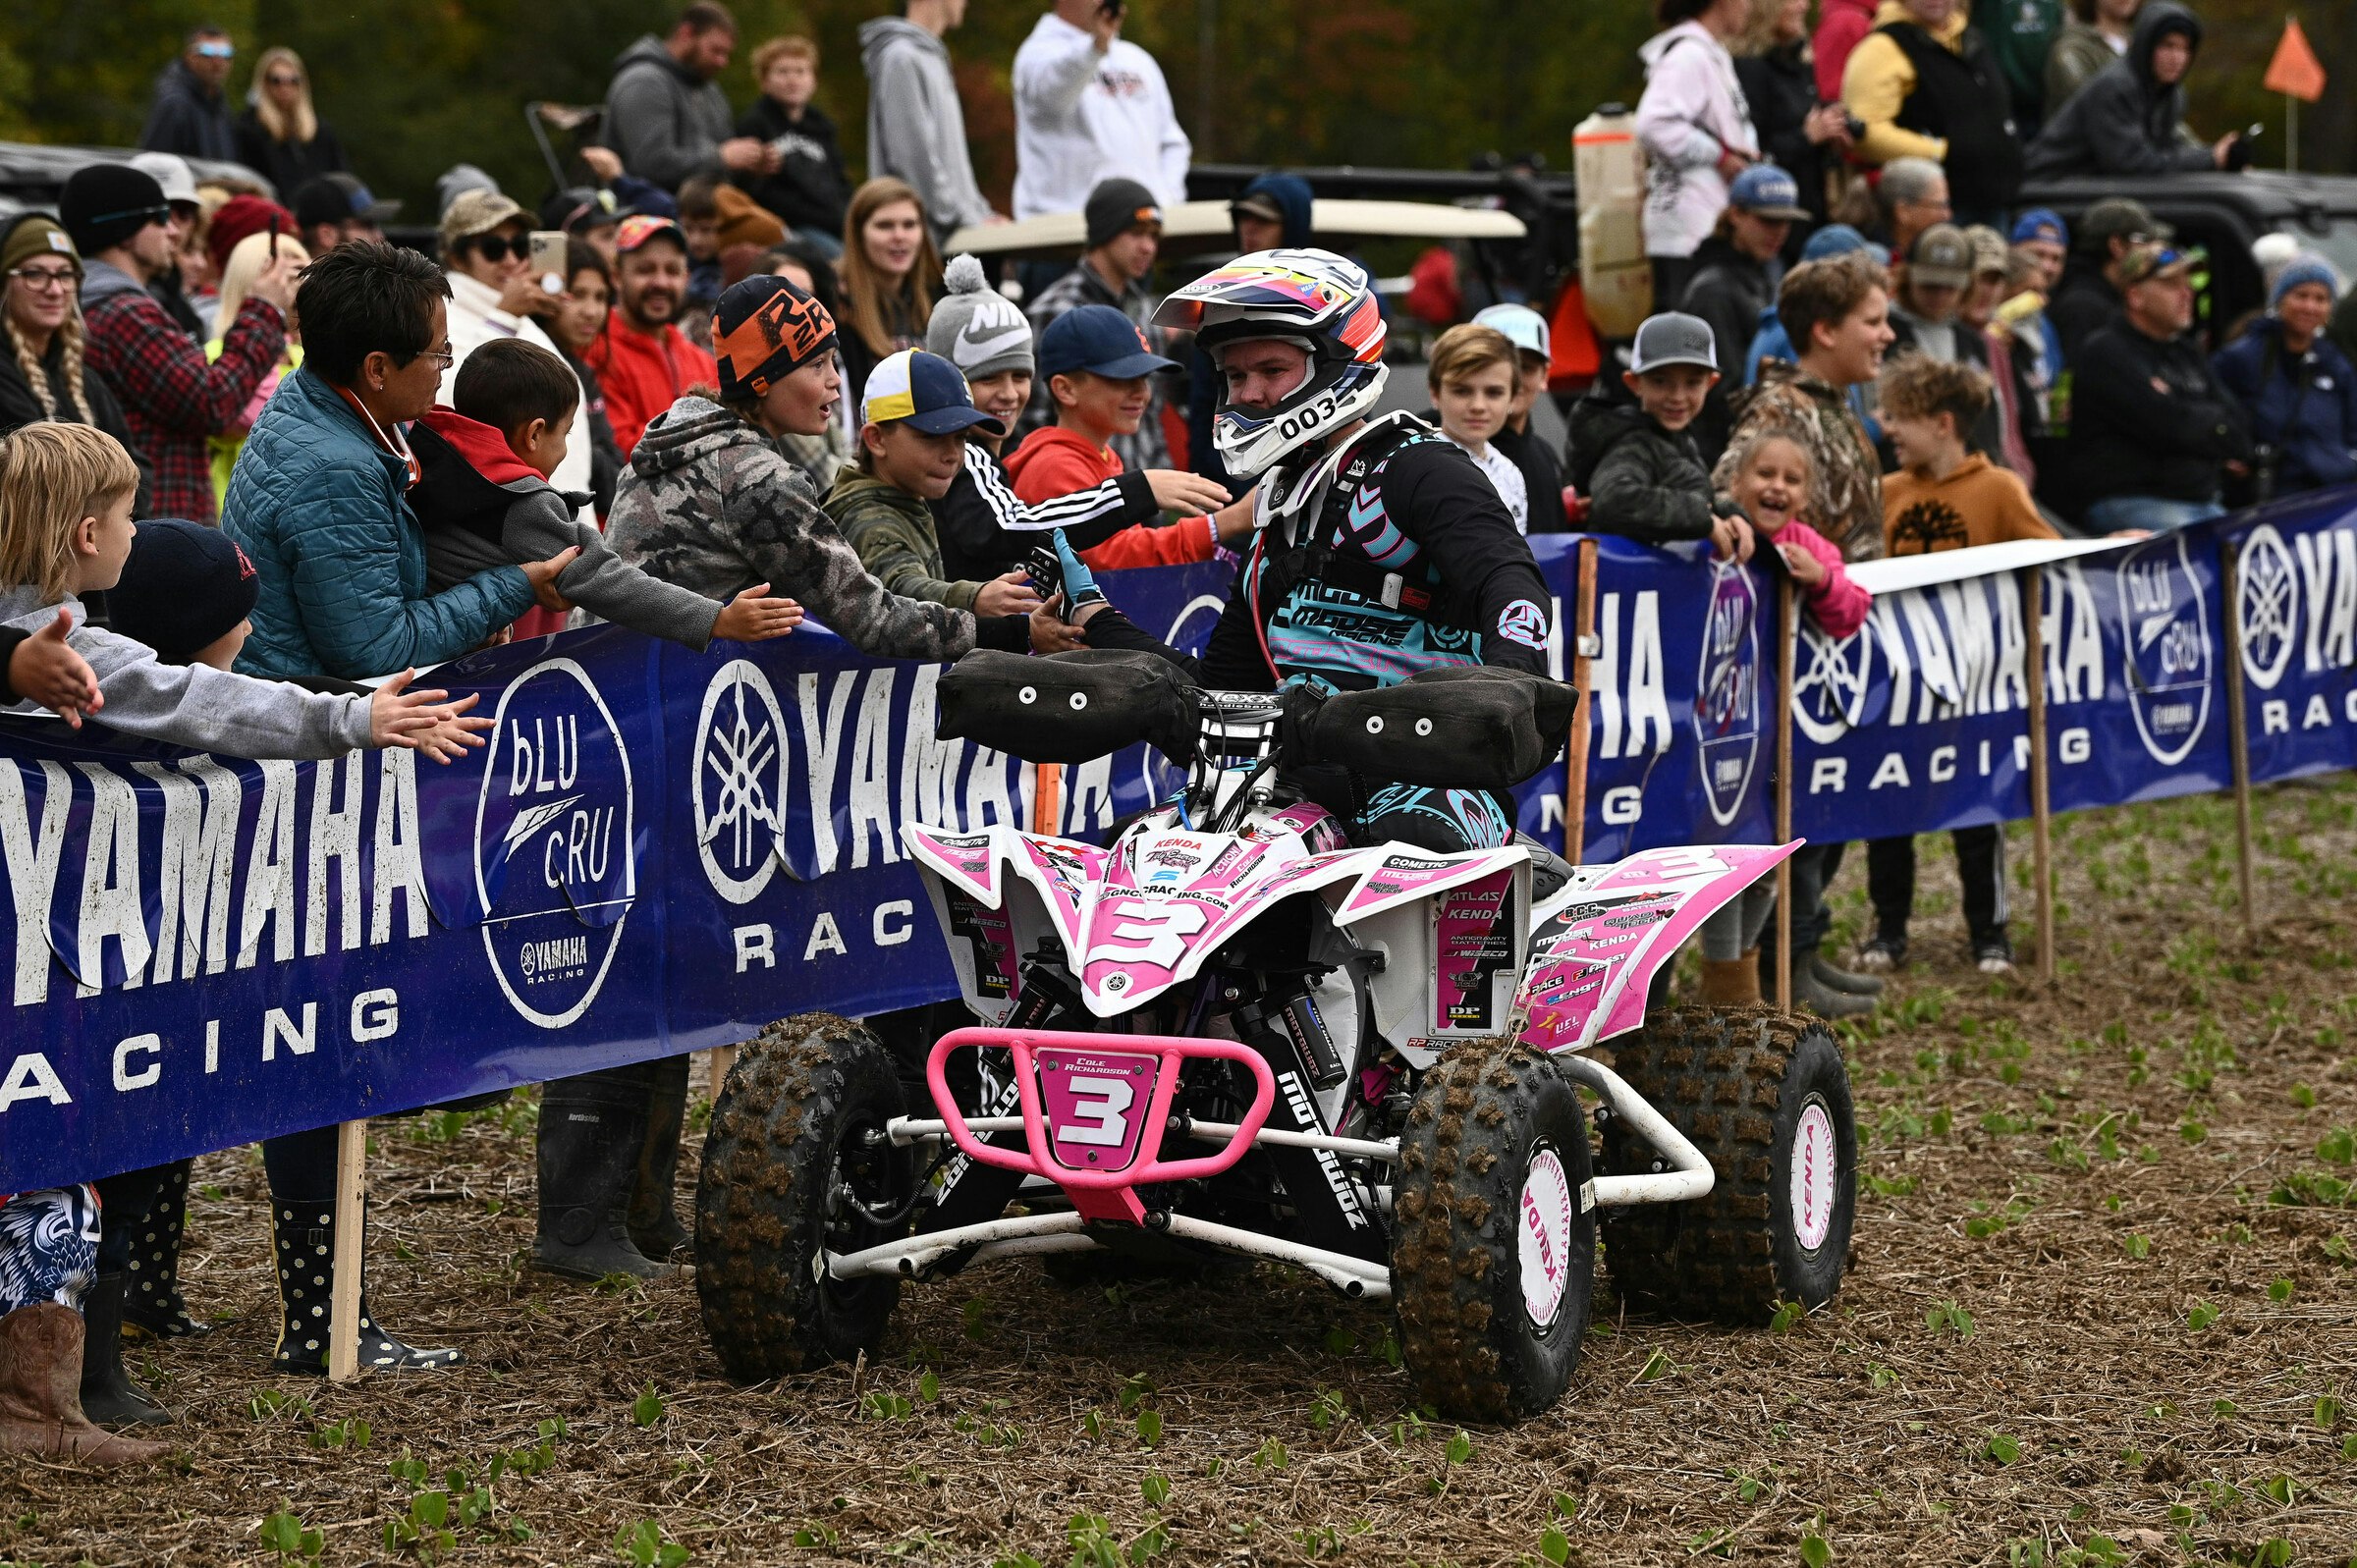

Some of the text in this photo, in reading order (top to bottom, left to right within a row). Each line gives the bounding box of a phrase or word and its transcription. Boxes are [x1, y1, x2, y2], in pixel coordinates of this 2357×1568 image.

[969, 302, 1029, 334] NIK
[1280, 397, 1337, 440] 003
[1871, 562, 2105, 727] YAMAHA
[1810, 729, 2091, 794] RACING
[1154, 838, 1202, 850] KENDA
[1390, 857, 1449, 869] COMETIC
[0, 747, 430, 1006] YAMAHA
[1448, 909, 1503, 920] KENDA
[1449, 892, 1501, 901] ATLAS
[535, 936, 587, 972] YAMAHA
[733, 898, 914, 973] RAC
[1083, 900, 1209, 972] 3
[1589, 932, 1638, 951] KENDA
[527, 968, 585, 986] RACING
[1450, 1006, 1480, 1015] DP
[0, 988, 398, 1113] ACING
[1408, 1038, 1426, 1047] RP
[1057, 1075, 1134, 1147] 3
[1804, 1124, 1815, 1229] KENDA
[1523, 1186, 1558, 1283] KENDA
